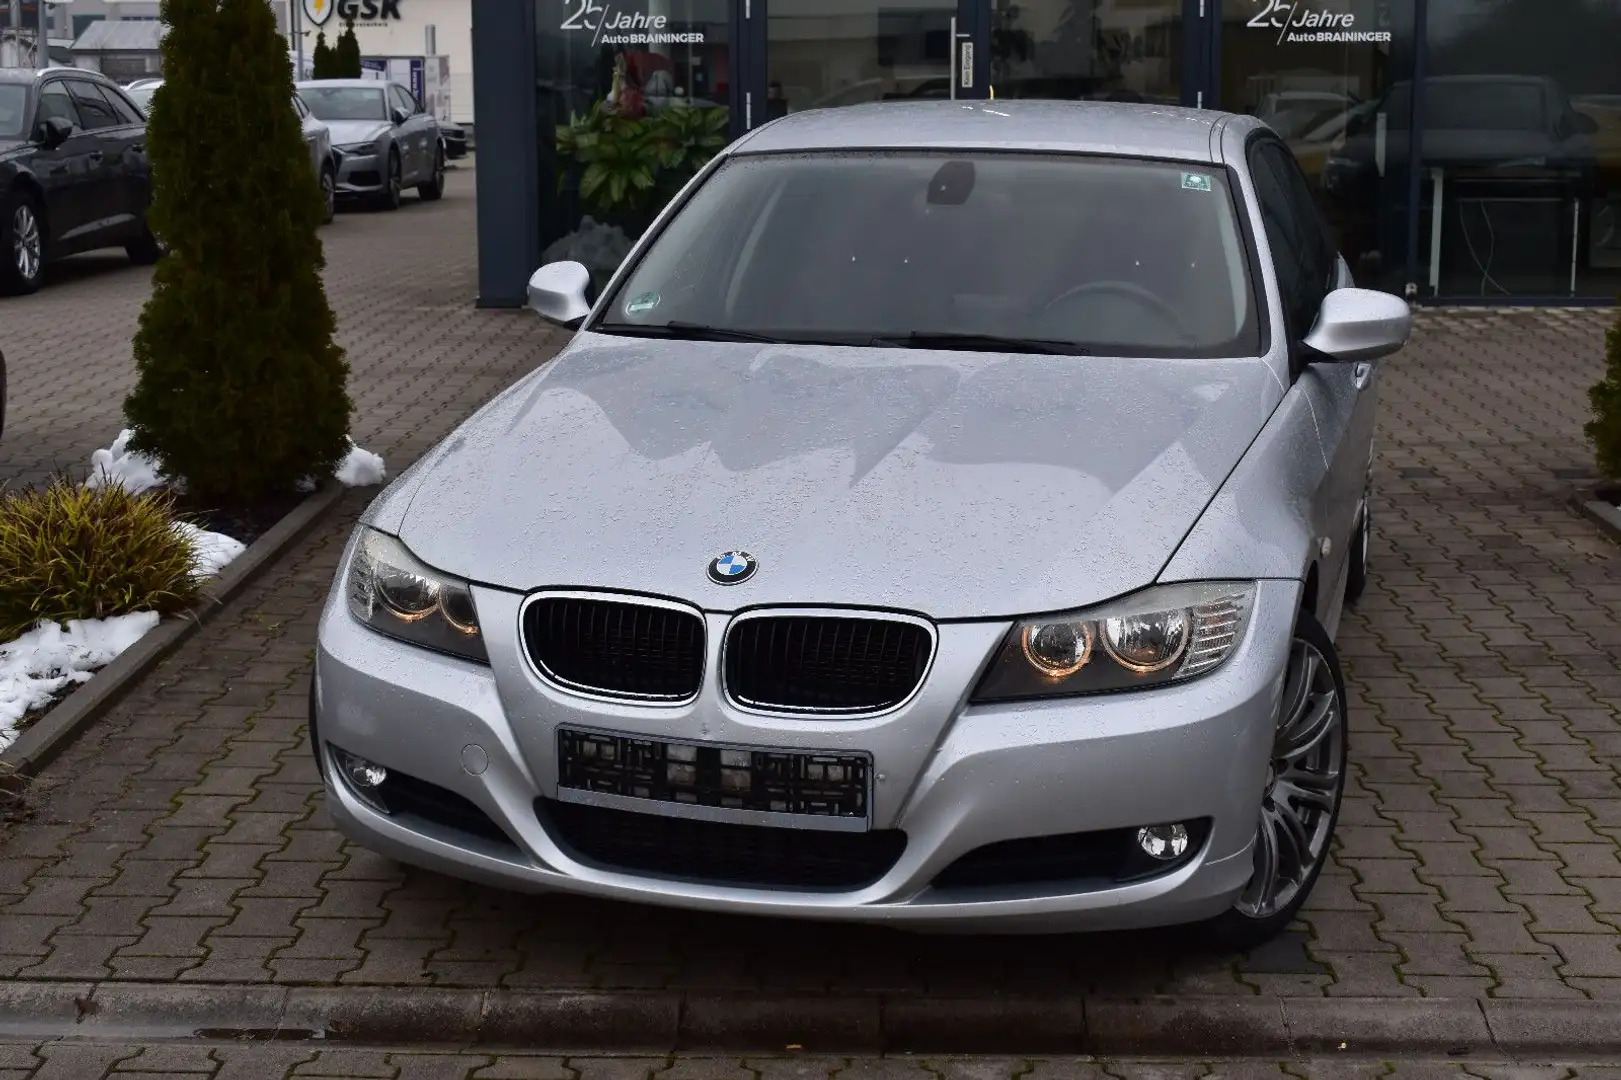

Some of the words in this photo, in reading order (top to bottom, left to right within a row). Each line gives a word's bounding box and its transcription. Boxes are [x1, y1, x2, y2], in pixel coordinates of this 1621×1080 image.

[337, 0, 401, 20] GSK
[560, 0, 603, 29] 25
[605, 11, 667, 29] Jahre
[1247, 0, 1291, 28] 25
[1292, 9, 1355, 28] Jahre
